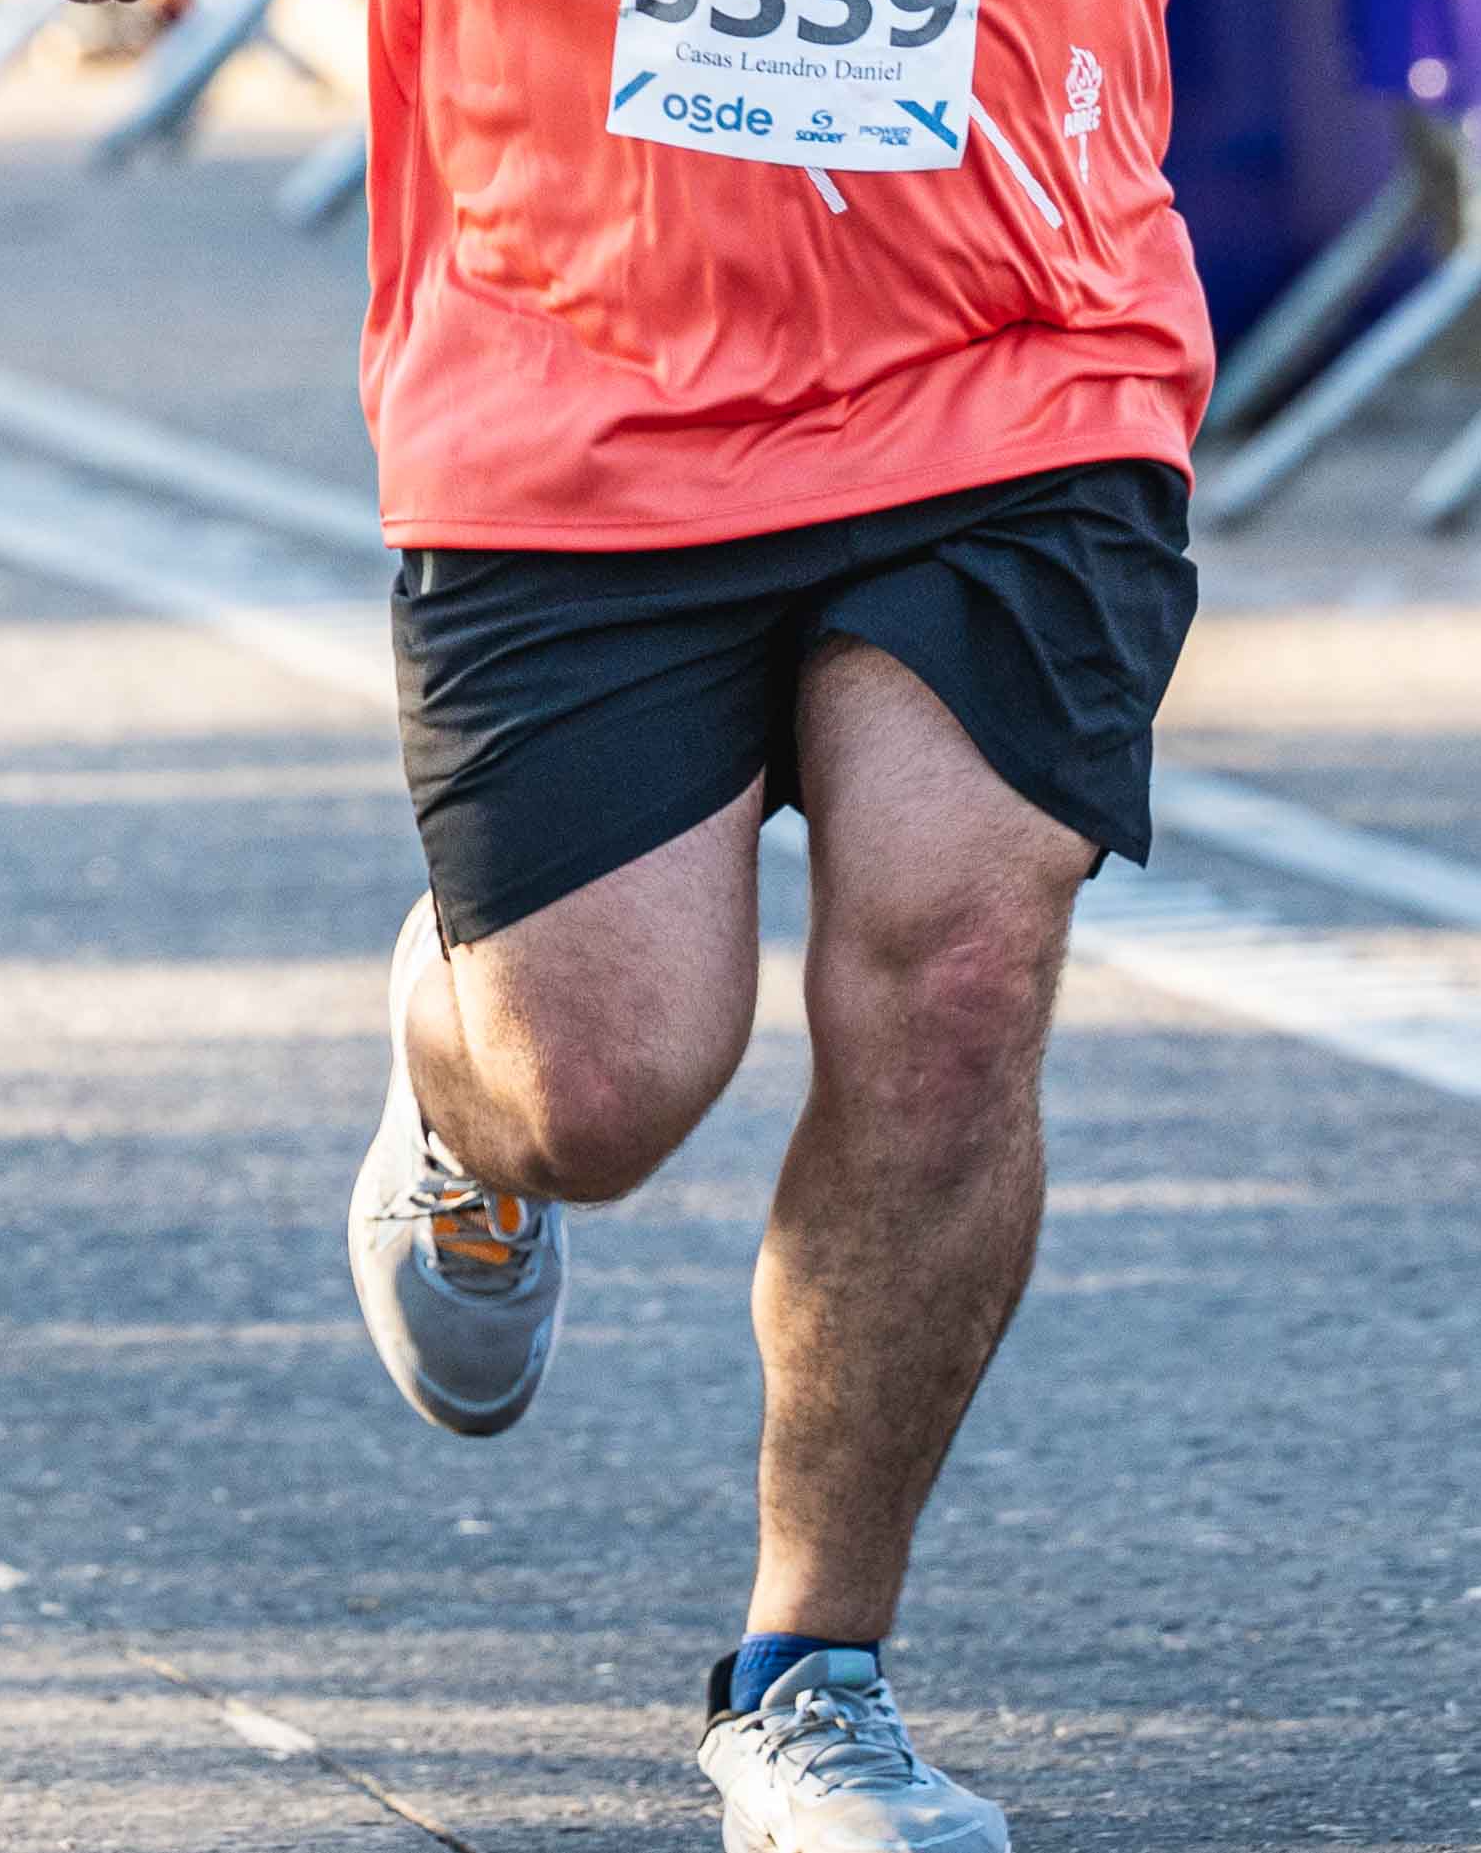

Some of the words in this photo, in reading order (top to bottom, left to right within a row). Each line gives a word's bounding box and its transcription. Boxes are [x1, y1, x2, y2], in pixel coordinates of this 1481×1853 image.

[676, 41, 733, 69] Casas
[741, 51, 828, 79] Leandro
[835, 59, 903, 81] Daniel
[662, 92, 774, 135] osde
